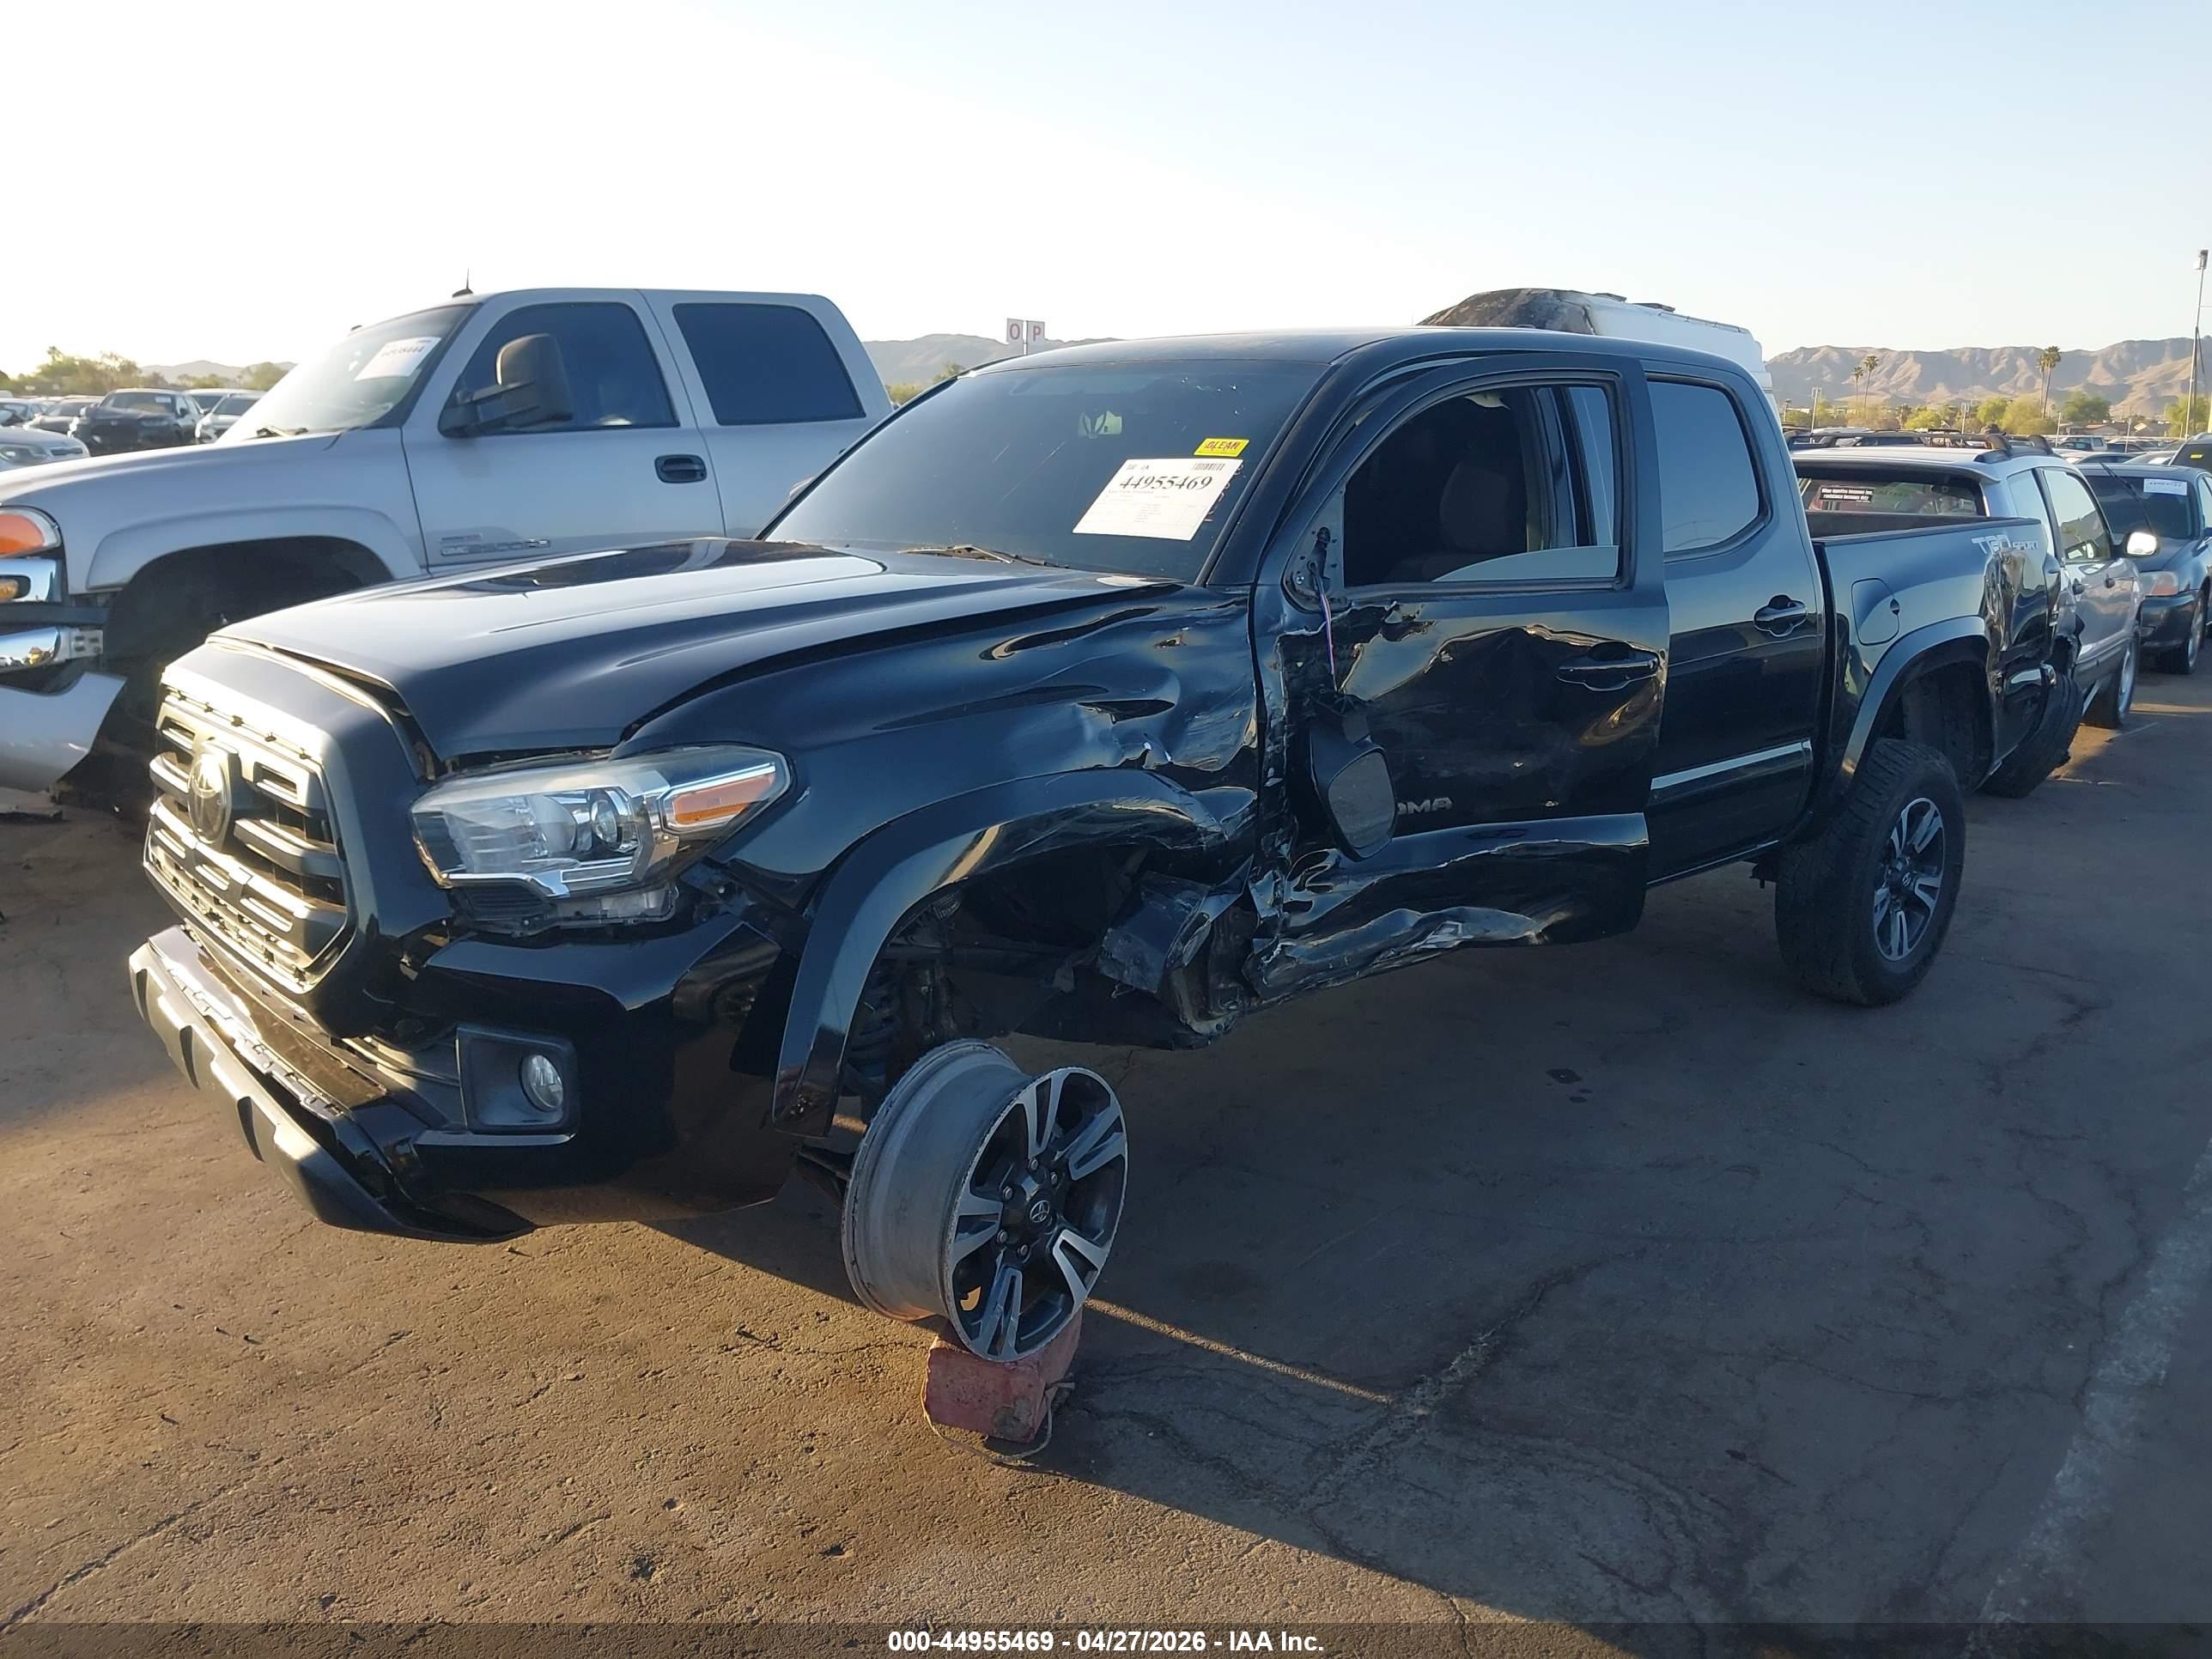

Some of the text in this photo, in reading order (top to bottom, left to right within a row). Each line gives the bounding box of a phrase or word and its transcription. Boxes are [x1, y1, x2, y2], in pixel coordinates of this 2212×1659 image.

[1010, 323, 1020, 340] O
[1033, 325, 1042, 342] P
[1119, 475, 1212, 490] 44955469
[2012, 541, 2040, 550] SPORT
